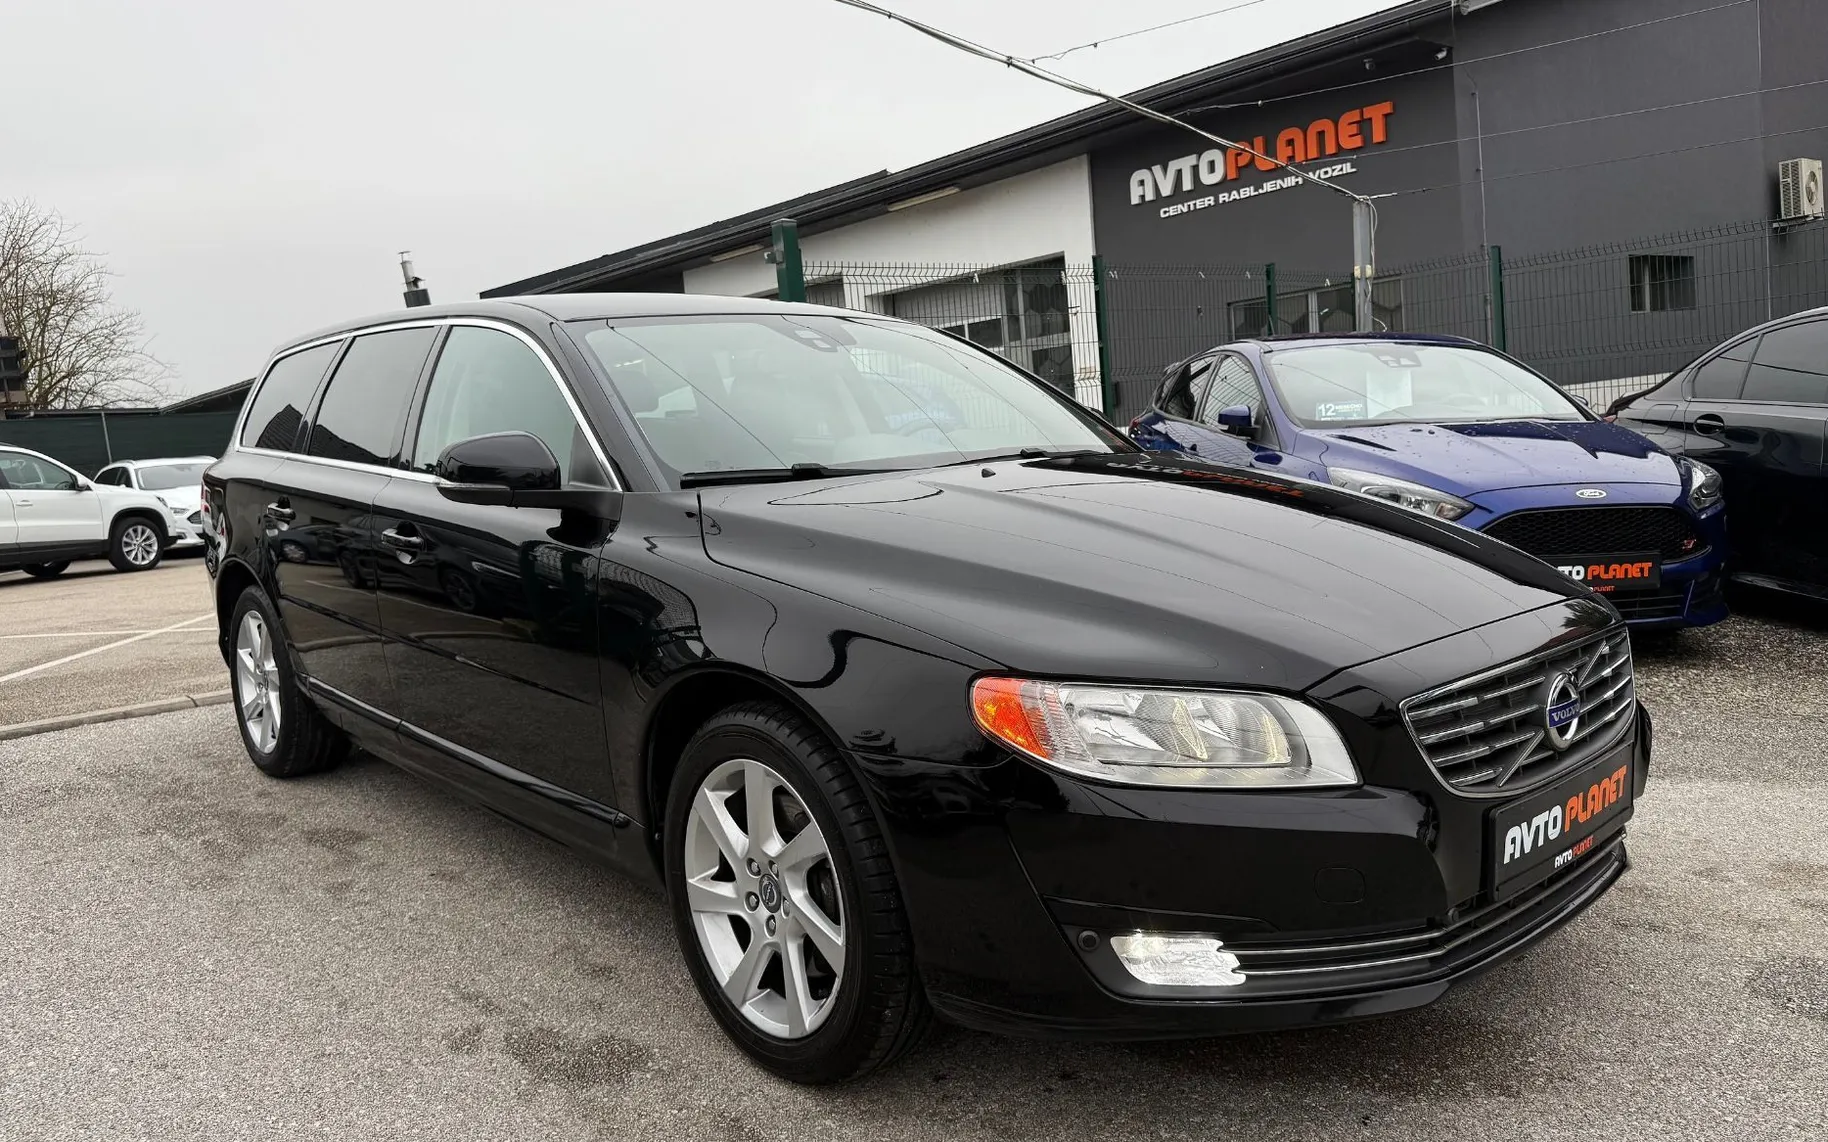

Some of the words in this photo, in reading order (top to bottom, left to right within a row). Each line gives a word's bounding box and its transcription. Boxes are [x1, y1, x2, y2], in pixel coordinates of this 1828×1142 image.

[1160, 196, 1215, 218] CENTER
[1219, 174, 1303, 203] RABLJENIH
[1307, 162, 1357, 180] VOZIL
[1318, 403, 1336, 416] 12
[1558, 565, 1585, 580] TO
[1587, 562, 1652, 580] PLANET
[1551, 703, 1580, 722] VOLVO
[1503, 805, 1562, 865] AVTO
[1564, 765, 1627, 832] PLANET
